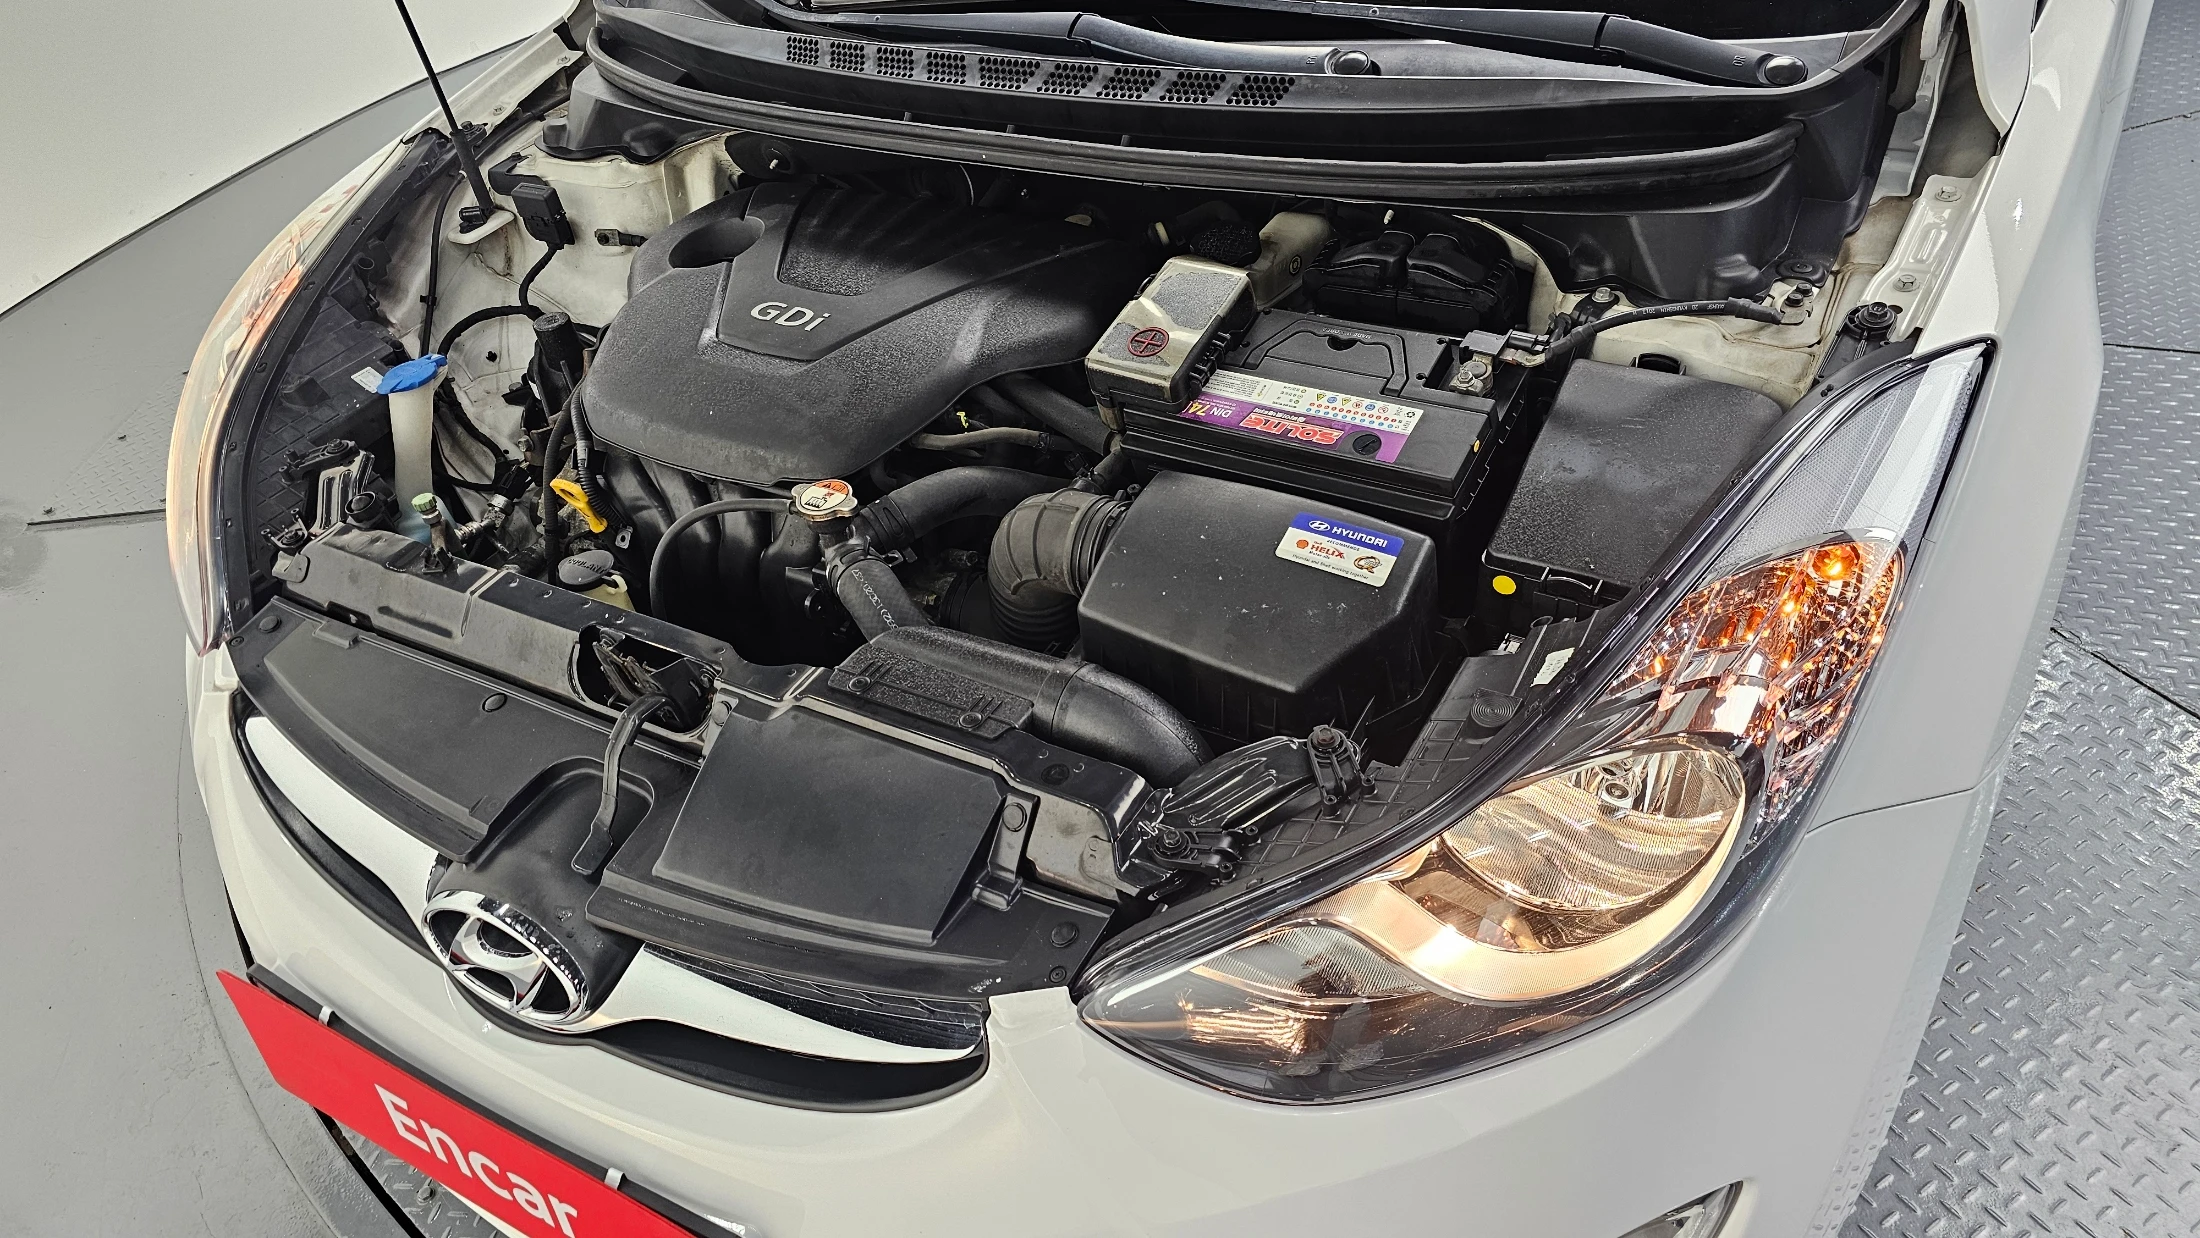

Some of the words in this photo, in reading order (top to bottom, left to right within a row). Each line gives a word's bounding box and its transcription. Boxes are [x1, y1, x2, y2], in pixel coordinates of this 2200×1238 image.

[750, 301, 832, 332] GDi
[1191, 401, 1209, 416] 74
[1210, 406, 1231, 419] DIN
[1240, 413, 1344, 445] SOLITE
[1331, 526, 1388, 548] HYUNDAI
[1310, 544, 1345, 559] HELIX
[568, 558, 608, 574] COOLANT
[1331, 564, 1349, 575] working
[1349, 571, 1369, 580] together
[374, 1083, 579, 1238] Encar
